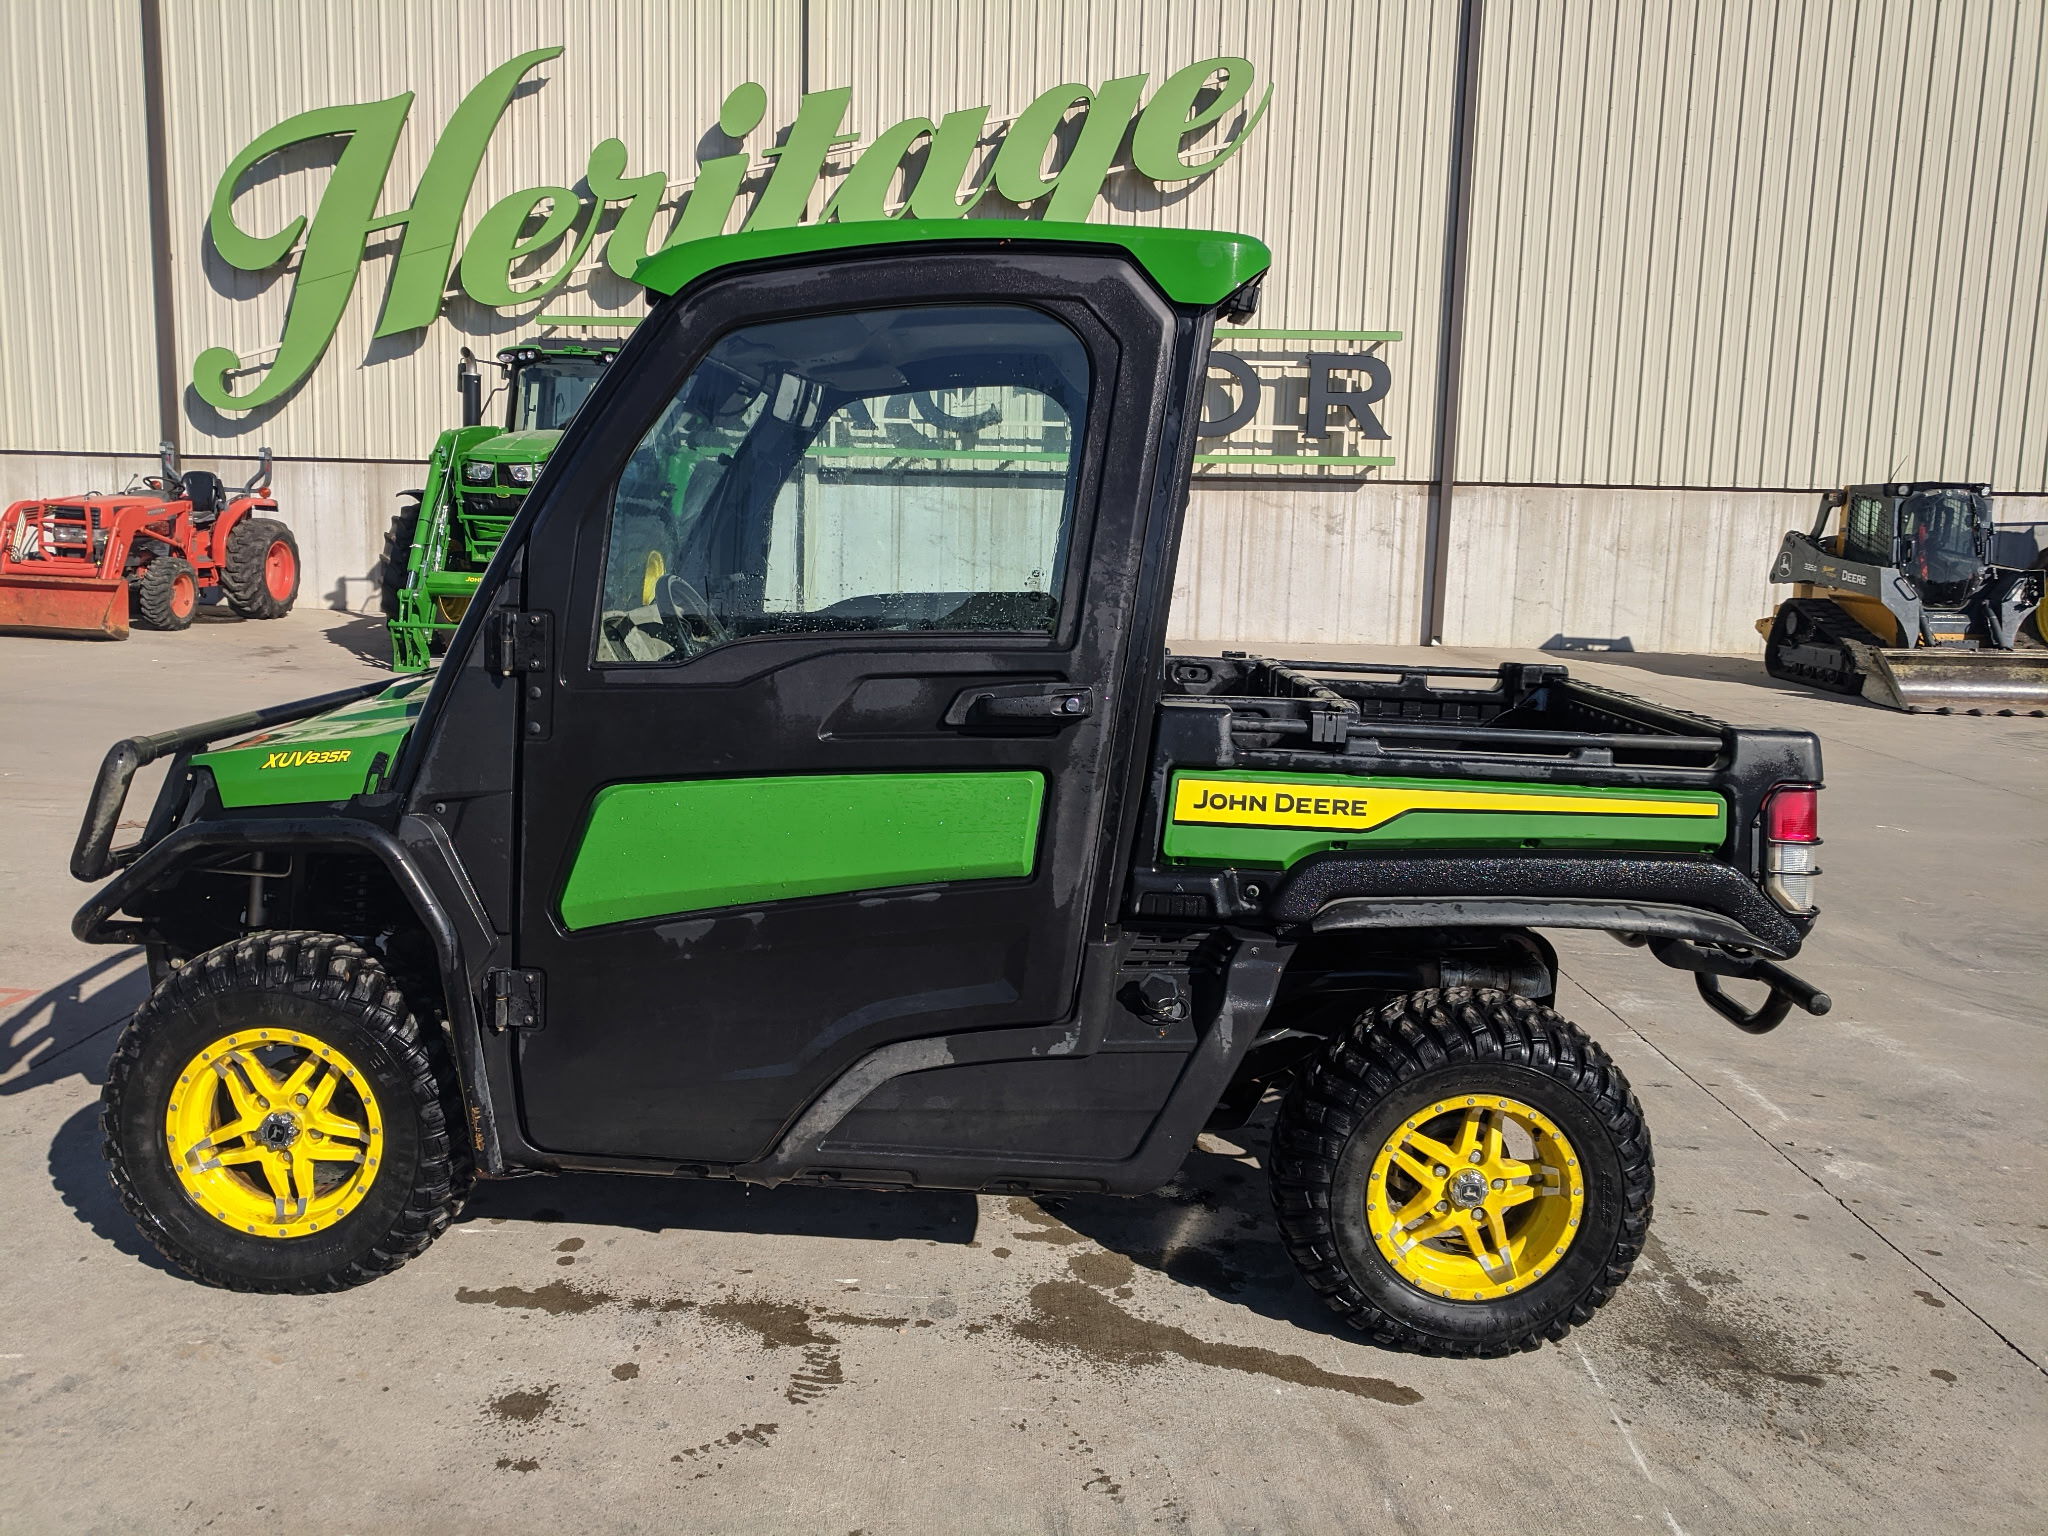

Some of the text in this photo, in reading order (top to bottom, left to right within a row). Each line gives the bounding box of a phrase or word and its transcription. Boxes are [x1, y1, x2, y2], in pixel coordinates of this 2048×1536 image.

[193, 46, 1274, 411] Heritage
[1841, 569, 1868, 586] DEERE
[260, 750, 352, 769] XUV835R
[1193, 789, 1368, 817] JOHN DEERE
